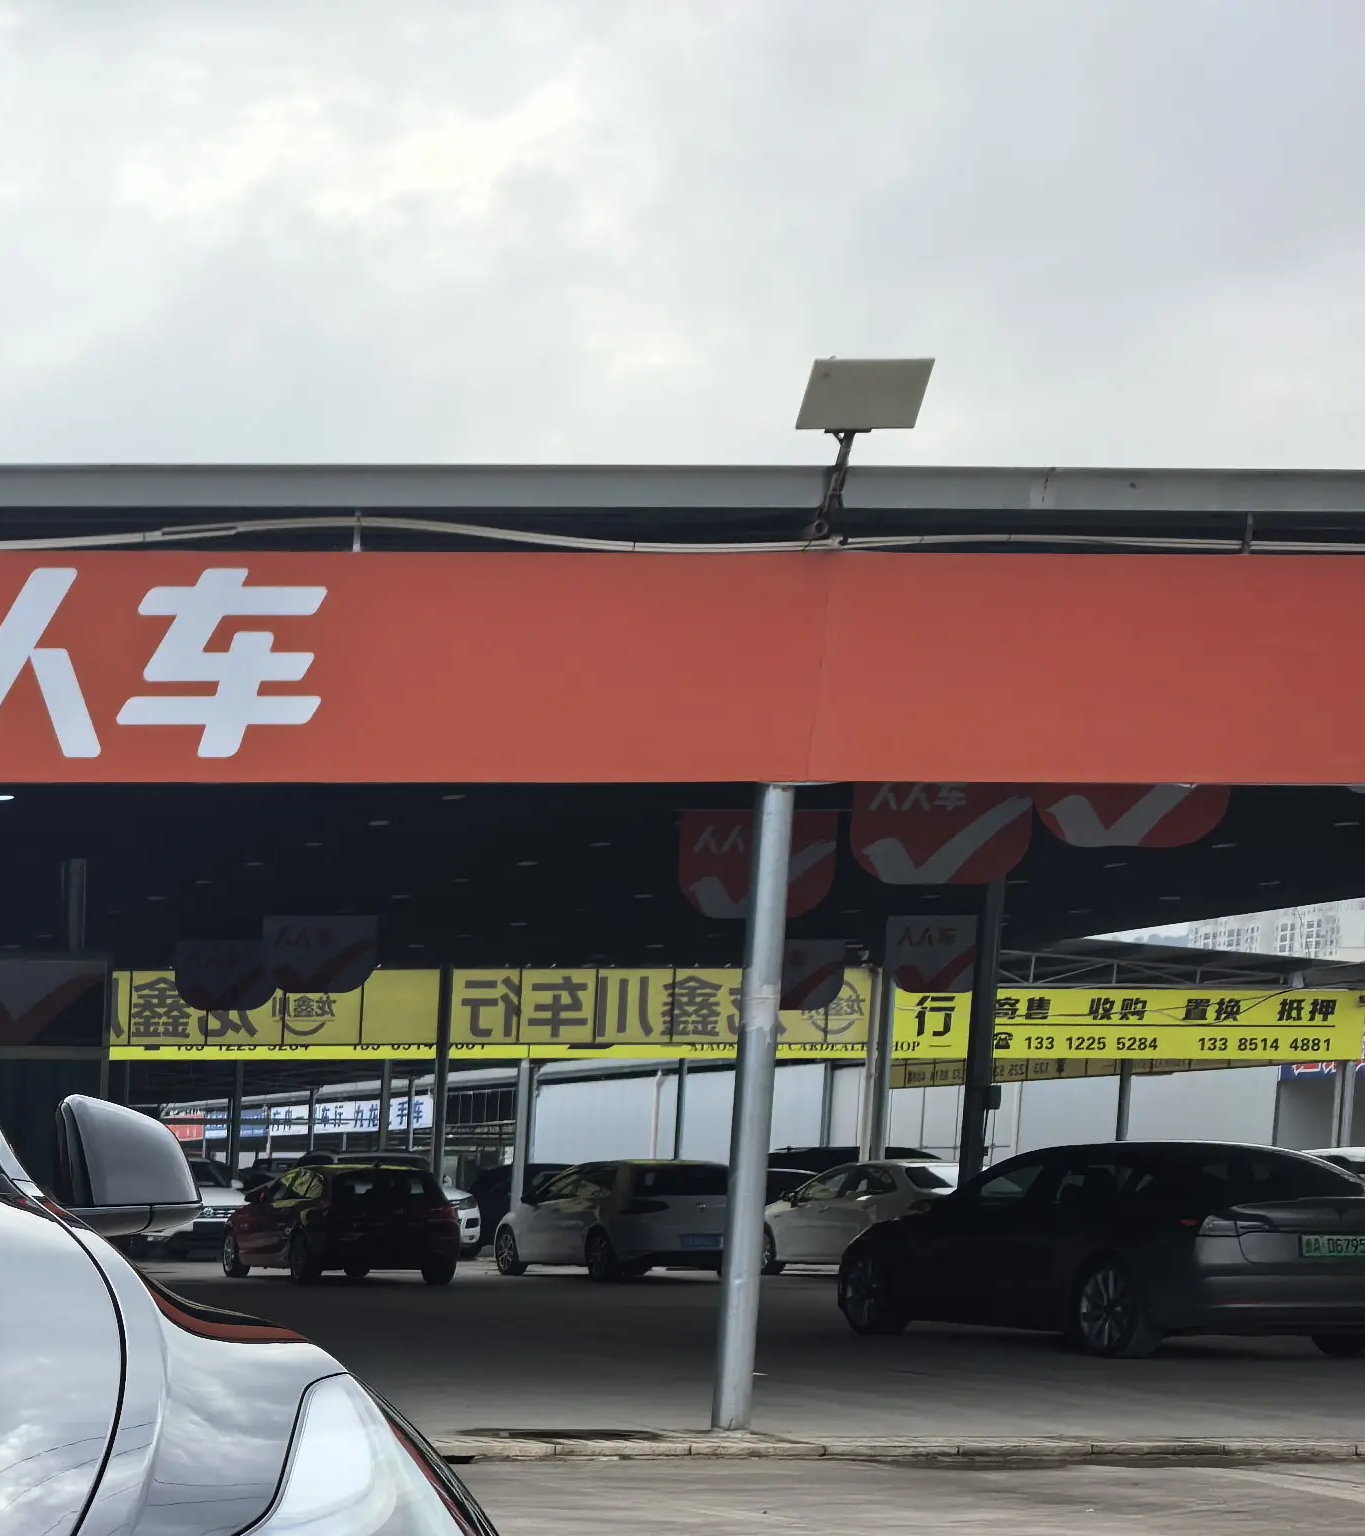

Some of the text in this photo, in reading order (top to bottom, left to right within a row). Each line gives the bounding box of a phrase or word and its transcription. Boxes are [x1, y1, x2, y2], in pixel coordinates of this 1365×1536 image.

[693, 824, 745, 853] 人人
[1089, 997, 1147, 1021] 收购
[1183, 997, 1242, 1022] 置换
[1277, 998, 1336, 1023] 抵押
[1024, 1036, 1331, 1052] 133 1225 5284 133 8514 4881
